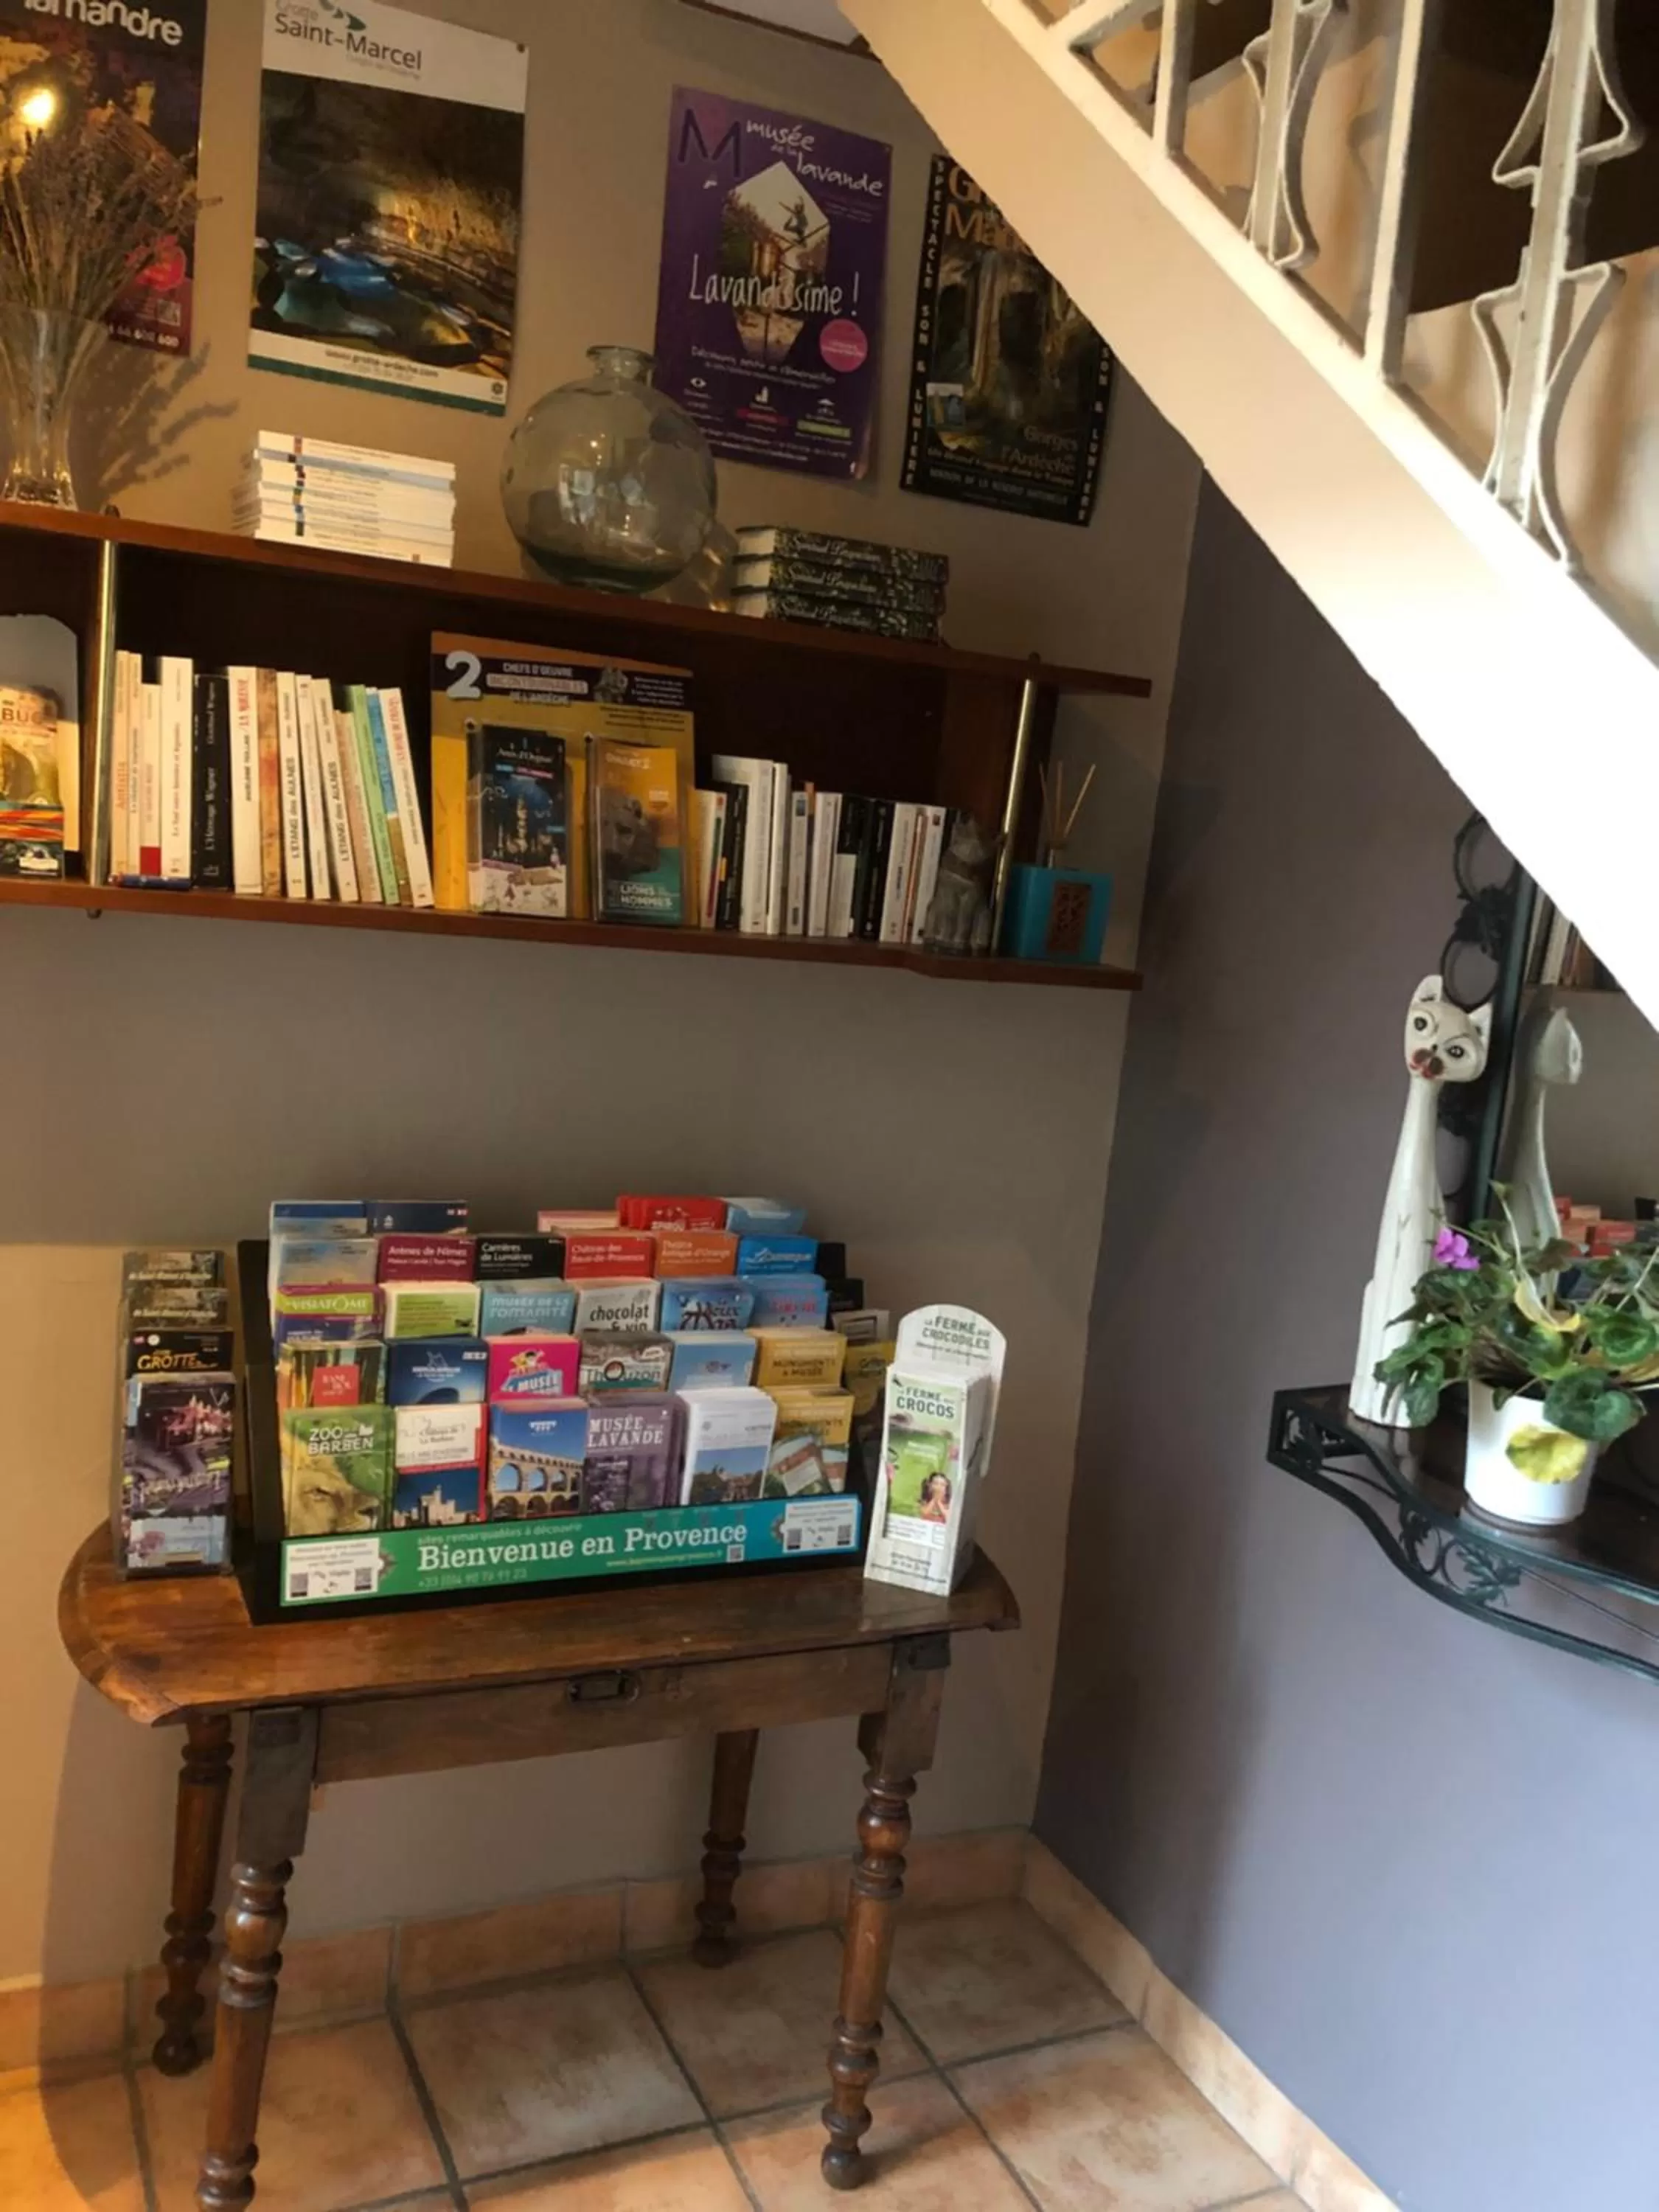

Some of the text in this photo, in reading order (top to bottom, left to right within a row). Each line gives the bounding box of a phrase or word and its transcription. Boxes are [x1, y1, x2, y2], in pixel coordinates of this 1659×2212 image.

[24, 0, 183, 46] amandre
[275, 13, 422, 70] Saint-Marcel
[746, 119, 815, 152] musée
[796, 152, 883, 197] lavande
[445, 650, 482, 699] 2
[590, 1302, 650, 1321] chocolat
[934, 1315, 976, 1335] FERME
[922, 1326, 990, 1349] CROCODILES
[137, 1352, 198, 1370] GROTTE
[905, 1386, 942, 1401] FERME
[896, 1396, 955, 1419] CROCOS
[589, 1413, 644, 1433] MUSÉE
[309, 1427, 344, 1441] ZOO
[588, 1430, 663, 1447] LAVANDE
[307, 1437, 374, 1455] BARBEN
[417, 1524, 748, 1572] Bienvenue en Provence
